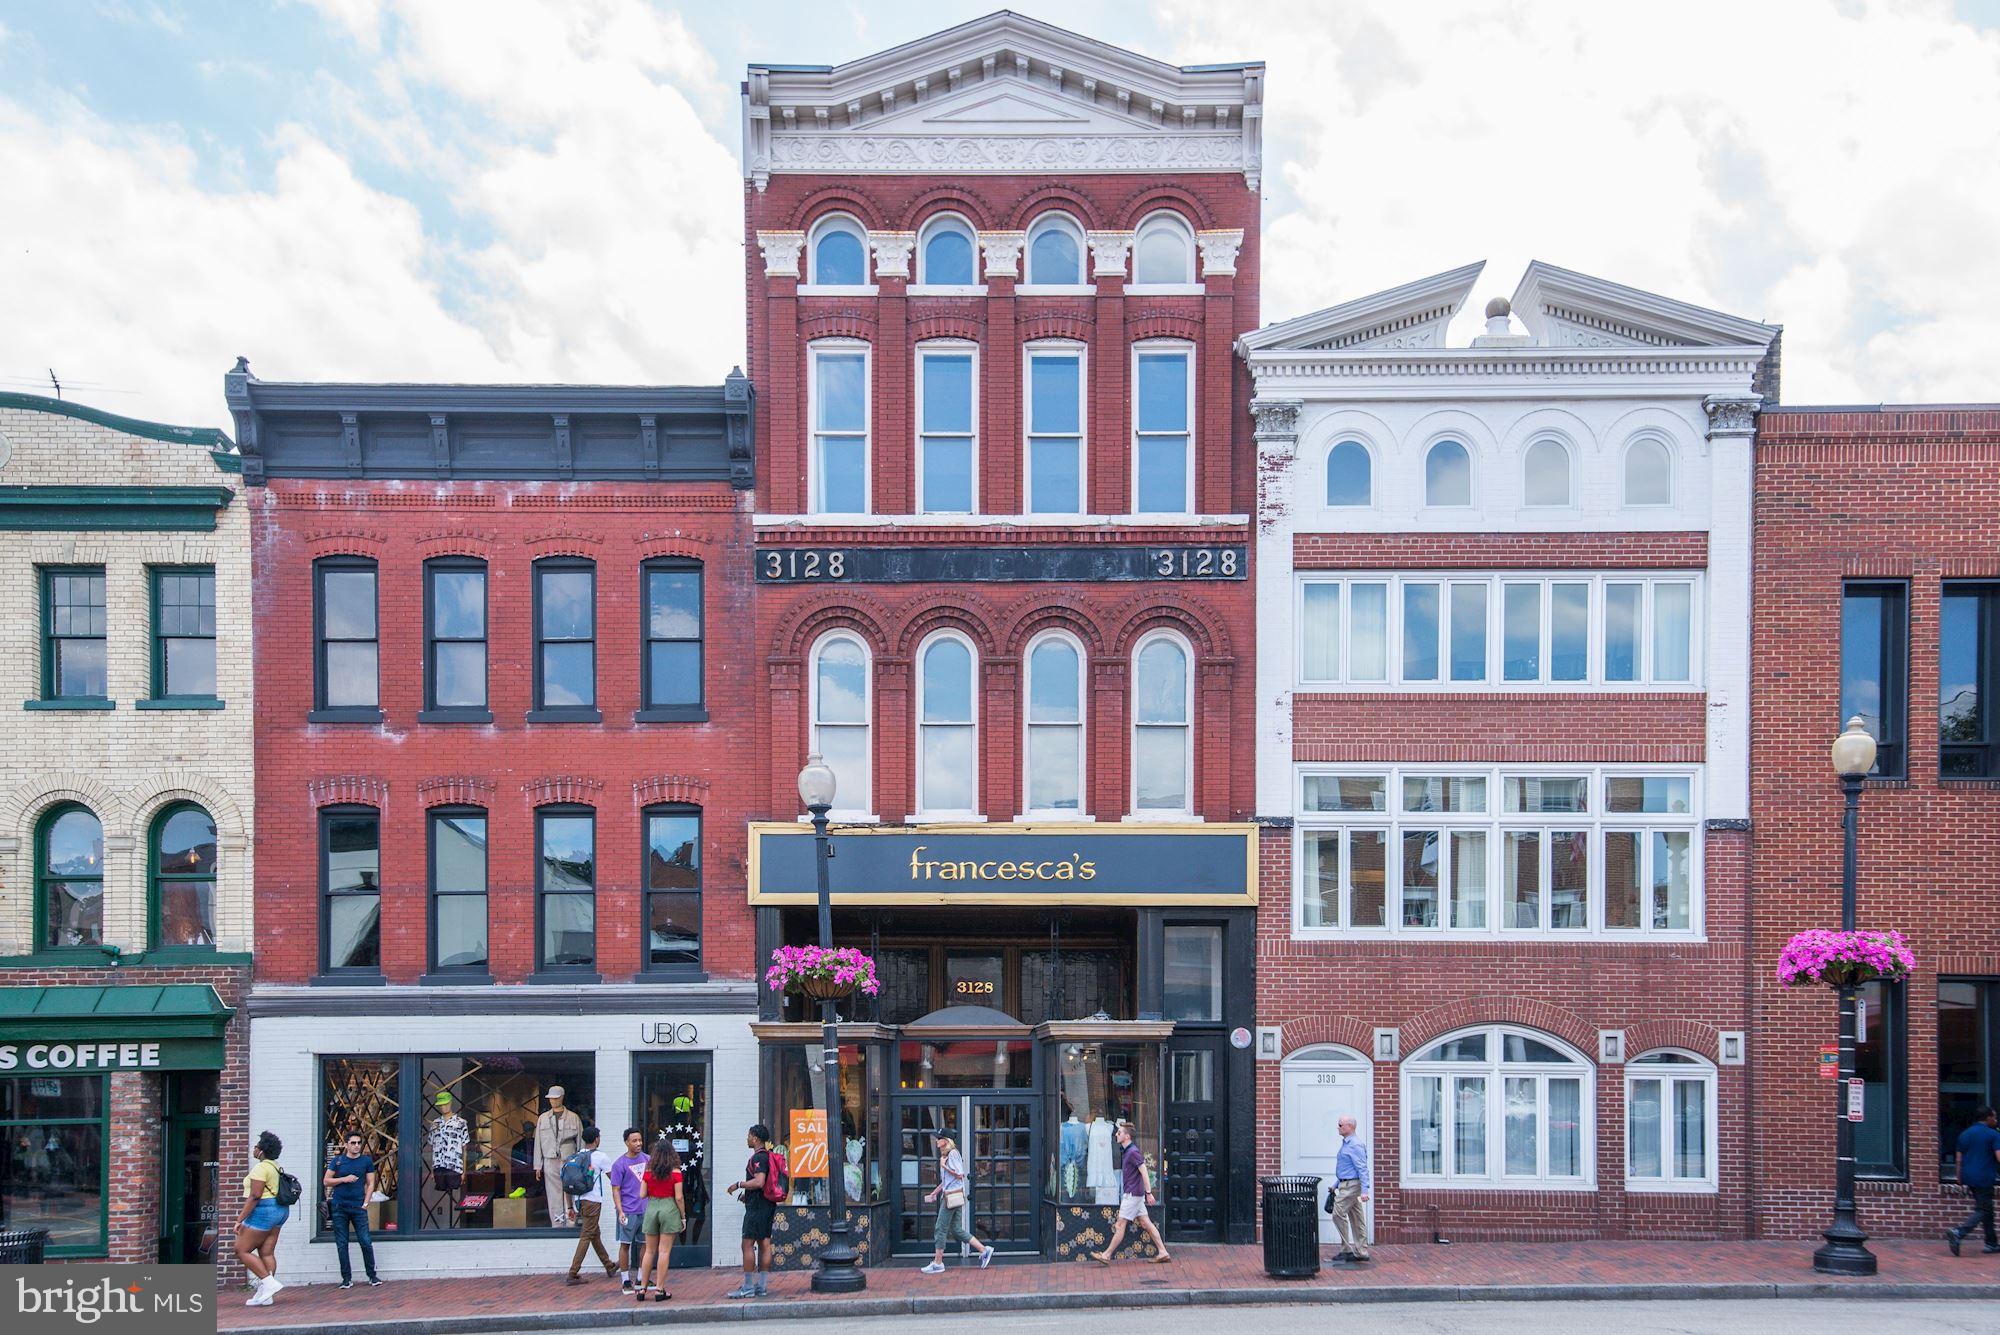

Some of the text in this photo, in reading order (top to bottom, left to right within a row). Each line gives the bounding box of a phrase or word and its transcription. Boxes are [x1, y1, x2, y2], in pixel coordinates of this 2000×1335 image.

[766, 551, 845, 578] 3128
[1158, 549, 1237, 576] 3128
[909, 846, 1097, 881] francesca's
[956, 981, 994, 994] 3128
[641, 1022, 698, 1044] UBIQ
[26, 1043, 160, 1069] COFFEE
[1317, 1074, 1336, 1084] 3130
[204, 1105, 220, 1114] 312
[797, 1122, 825, 1134] SAL
[200, 1204, 218, 1213] COL
[200, 1212, 218, 1221] BRE
